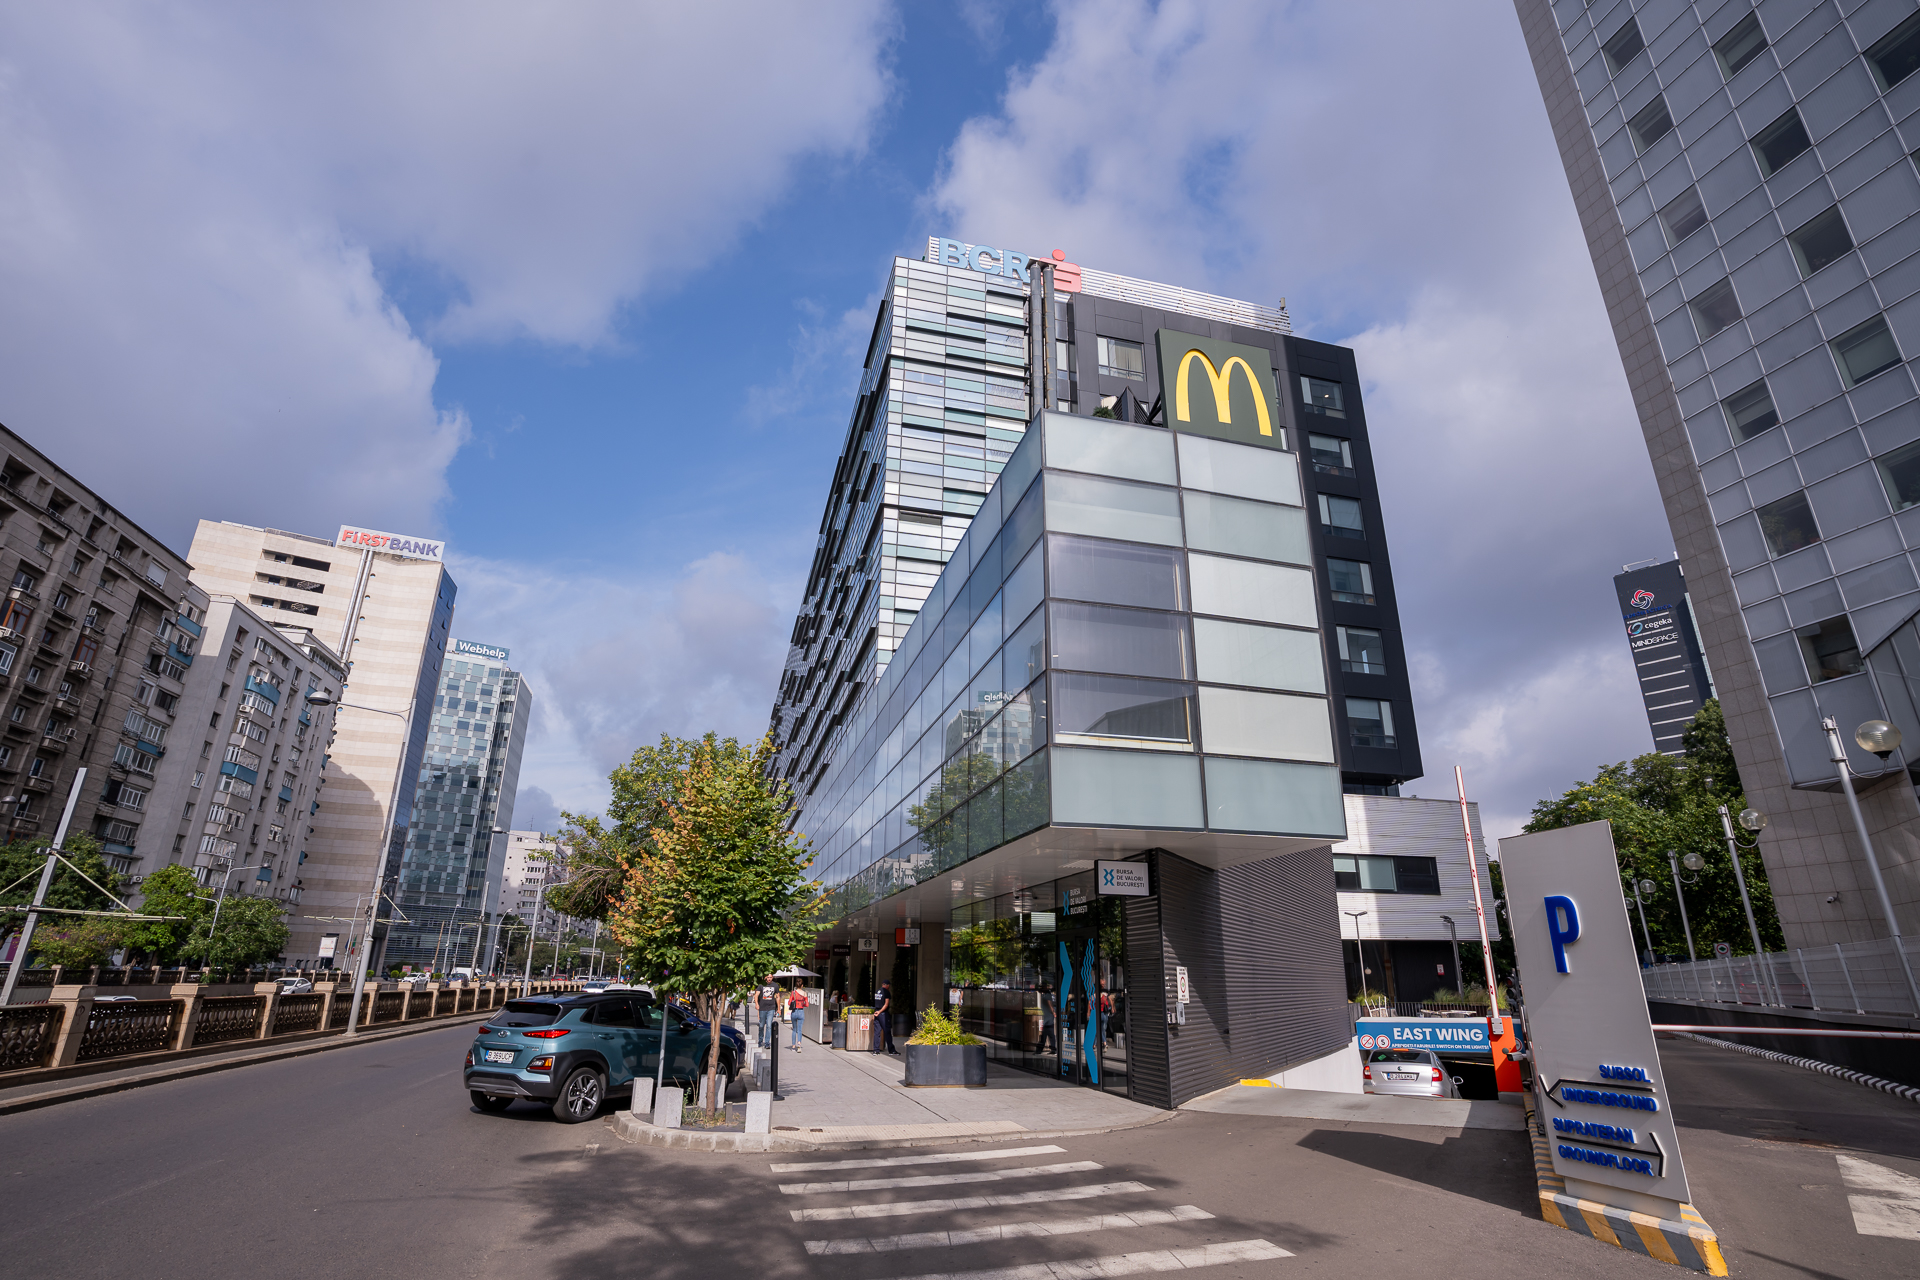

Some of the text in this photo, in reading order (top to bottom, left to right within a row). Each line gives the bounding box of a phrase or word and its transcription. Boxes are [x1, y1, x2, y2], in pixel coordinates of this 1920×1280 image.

[939, 237, 1030, 283] BCR
[1645, 618, 1672, 629] cegeka
[459, 641, 506, 659] Webhelp
[1632, 632, 1678, 648] MINDSPACE
[1070, 888, 1080, 897] BURSA
[1544, 895, 1581, 974] P
[1393, 1027, 1483, 1042] EAST WING
[1599, 1064, 1654, 1084] SUBSOL
[1561, 1087, 1659, 1112] UNDERGROUND
[1553, 1117, 1637, 1144] SUPRATERAN
[1558, 1144, 1655, 1177] GROUNDFLOOR
